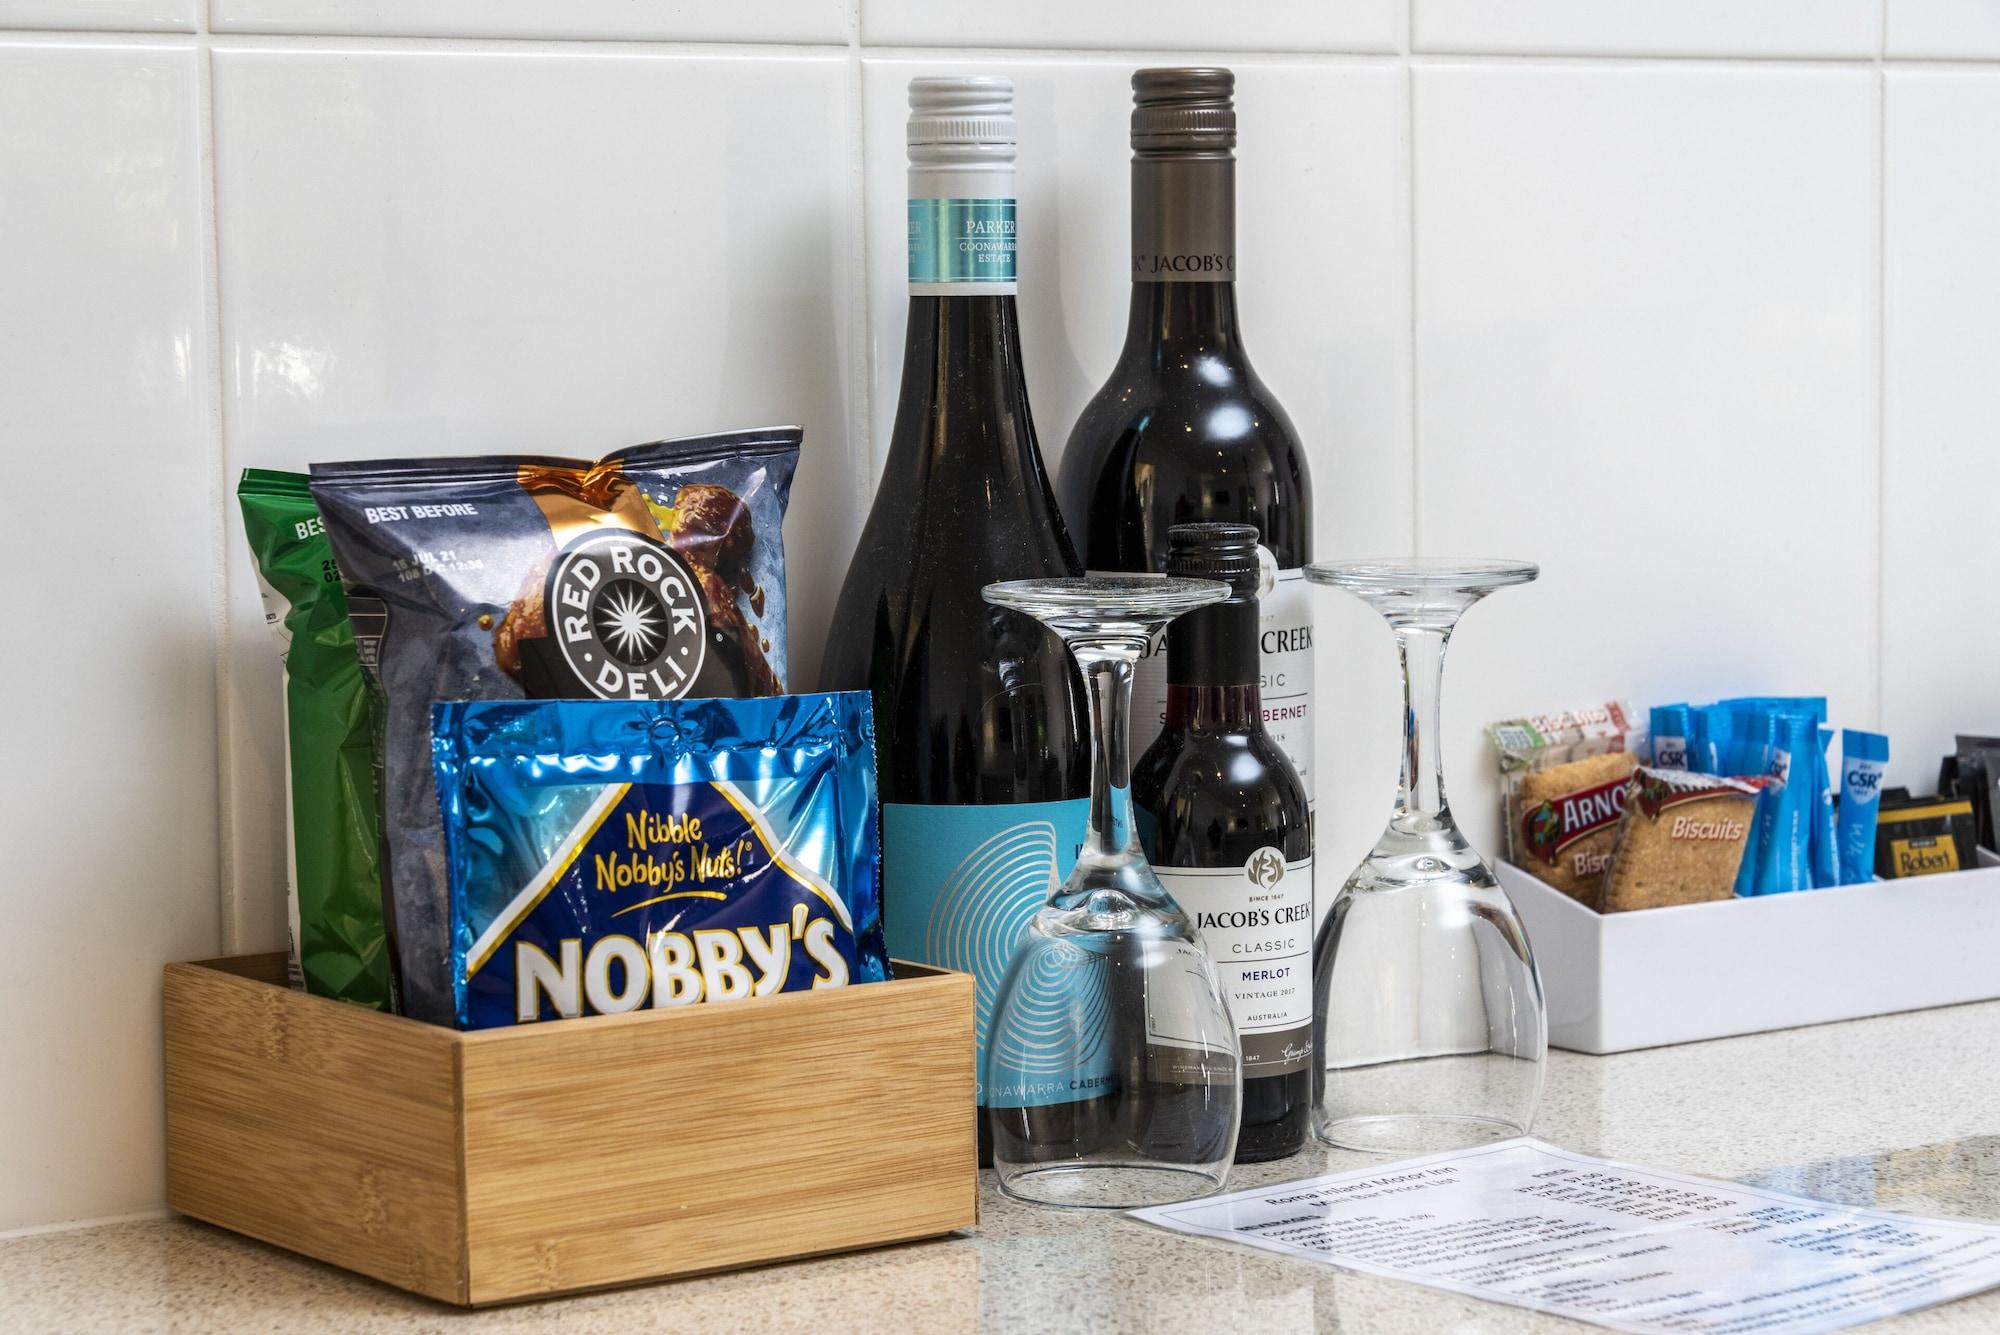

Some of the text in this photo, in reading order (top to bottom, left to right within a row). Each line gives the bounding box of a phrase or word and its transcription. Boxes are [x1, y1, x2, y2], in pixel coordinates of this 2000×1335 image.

[966, 220, 1015, 233] PARKER
[978, 254, 1011, 263] ESTATE
[1150, 253, 1223, 273] JACOB'S
[364, 503, 478, 524] BEST BEFORE
[294, 516, 328, 540] BES
[562, 546, 697, 643] RED ROCK
[1261, 626, 1312, 654] CREEK
[596, 656, 687, 700] DELI
[1263, 704, 1307, 722] BERNET
[1848, 771, 1879, 790] CSR
[1563, 784, 1628, 833] ARNO
[626, 809, 703, 849] Nibble
[1671, 815, 1744, 842] Biscuits
[596, 850, 685, 893] Nobby's
[1574, 852, 1612, 877] Bisc
[1900, 851, 1951, 871] Robert
[1197, 902, 1311, 929] JACOB'S CREEK
[1232, 938, 1295, 954] CLASSIC
[515, 903, 850, 1024] NOBBY'S
[1242, 968, 1291, 981] MERLOT
[1235, 990, 1279, 1000] VINTAGE
[1248, 1012, 1288, 1021] AUSTRALIA
[1265, 1166, 1457, 1205] Roma Inland Motor Inn
[1381, 1184, 1426, 1194] Price
